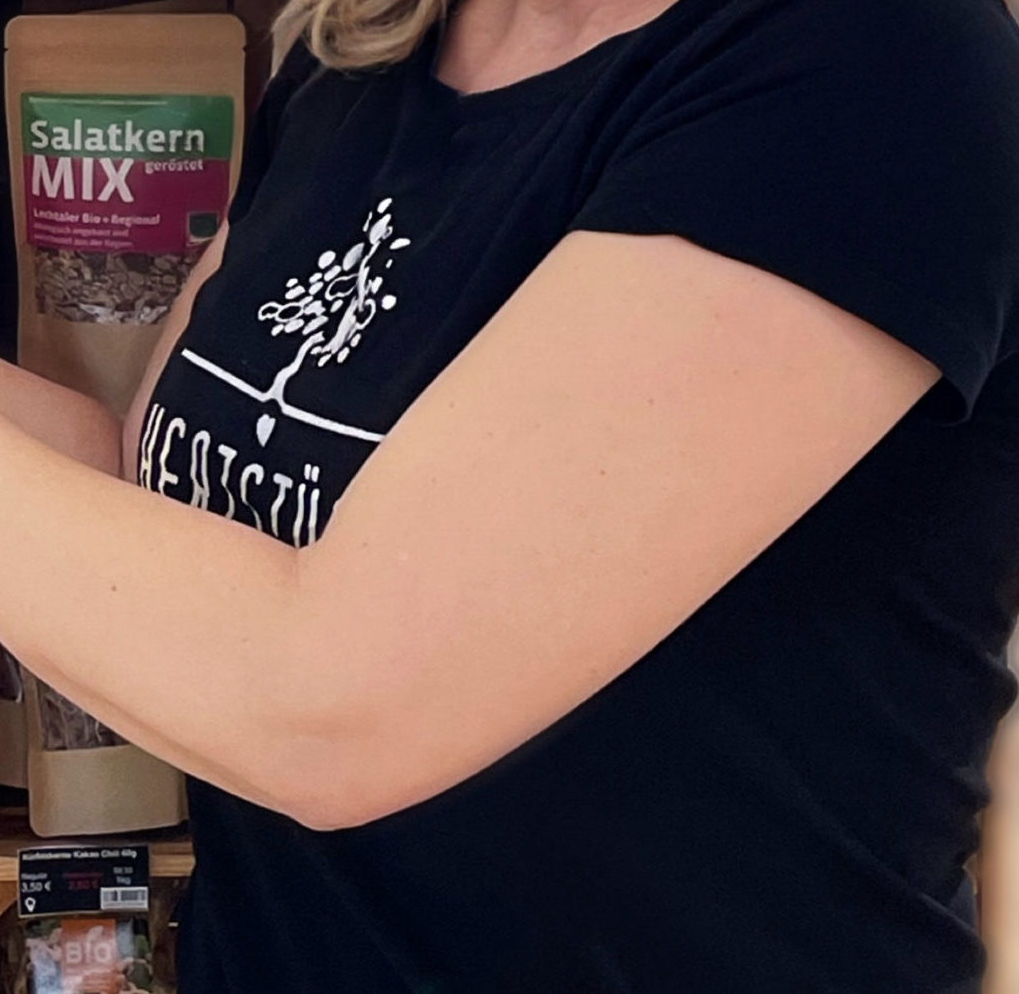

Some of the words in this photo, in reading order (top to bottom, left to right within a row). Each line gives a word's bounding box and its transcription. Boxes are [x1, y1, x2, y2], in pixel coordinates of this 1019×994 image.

[30, 118, 205, 153] Salatkern
[31, 153, 135, 204] MIX
[144, 158, 204, 175] geröstet
[110, 213, 160, 228] Regional
[72, 850, 100, 859] Kakao
[100, 849, 120, 858] Chili
